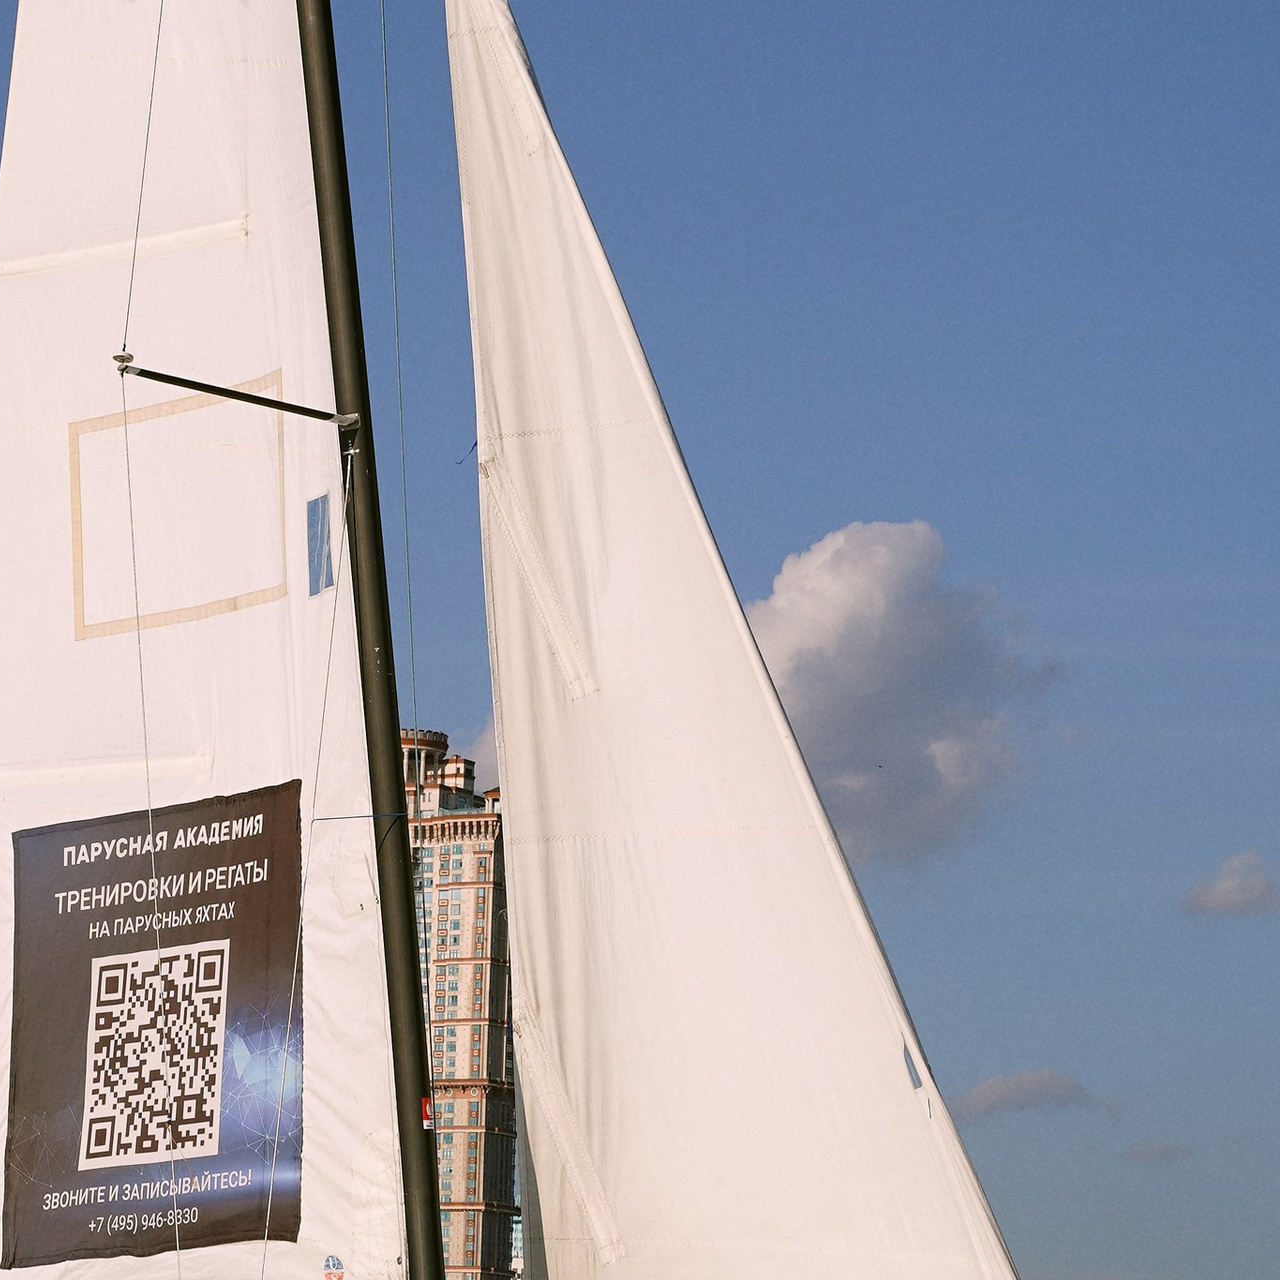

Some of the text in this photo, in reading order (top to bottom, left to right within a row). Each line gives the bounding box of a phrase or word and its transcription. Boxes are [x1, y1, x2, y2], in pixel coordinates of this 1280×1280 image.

[63, 814, 264, 867] ПАРУСНАЯ АКАДЕМИЯ
[54, 858, 268, 915] ТРЕНИРОВКИ И РЕГАТЫ
[88, 901, 236, 940] НА ПАРУСНЫХ ЯХТАХ
[42, 1169, 252, 1211] ЗВОНИТЕ И ЗАПИСЫВАЙТЕСЬ!
[88, 1207, 199, 1236] +7 (495) 946-8330
